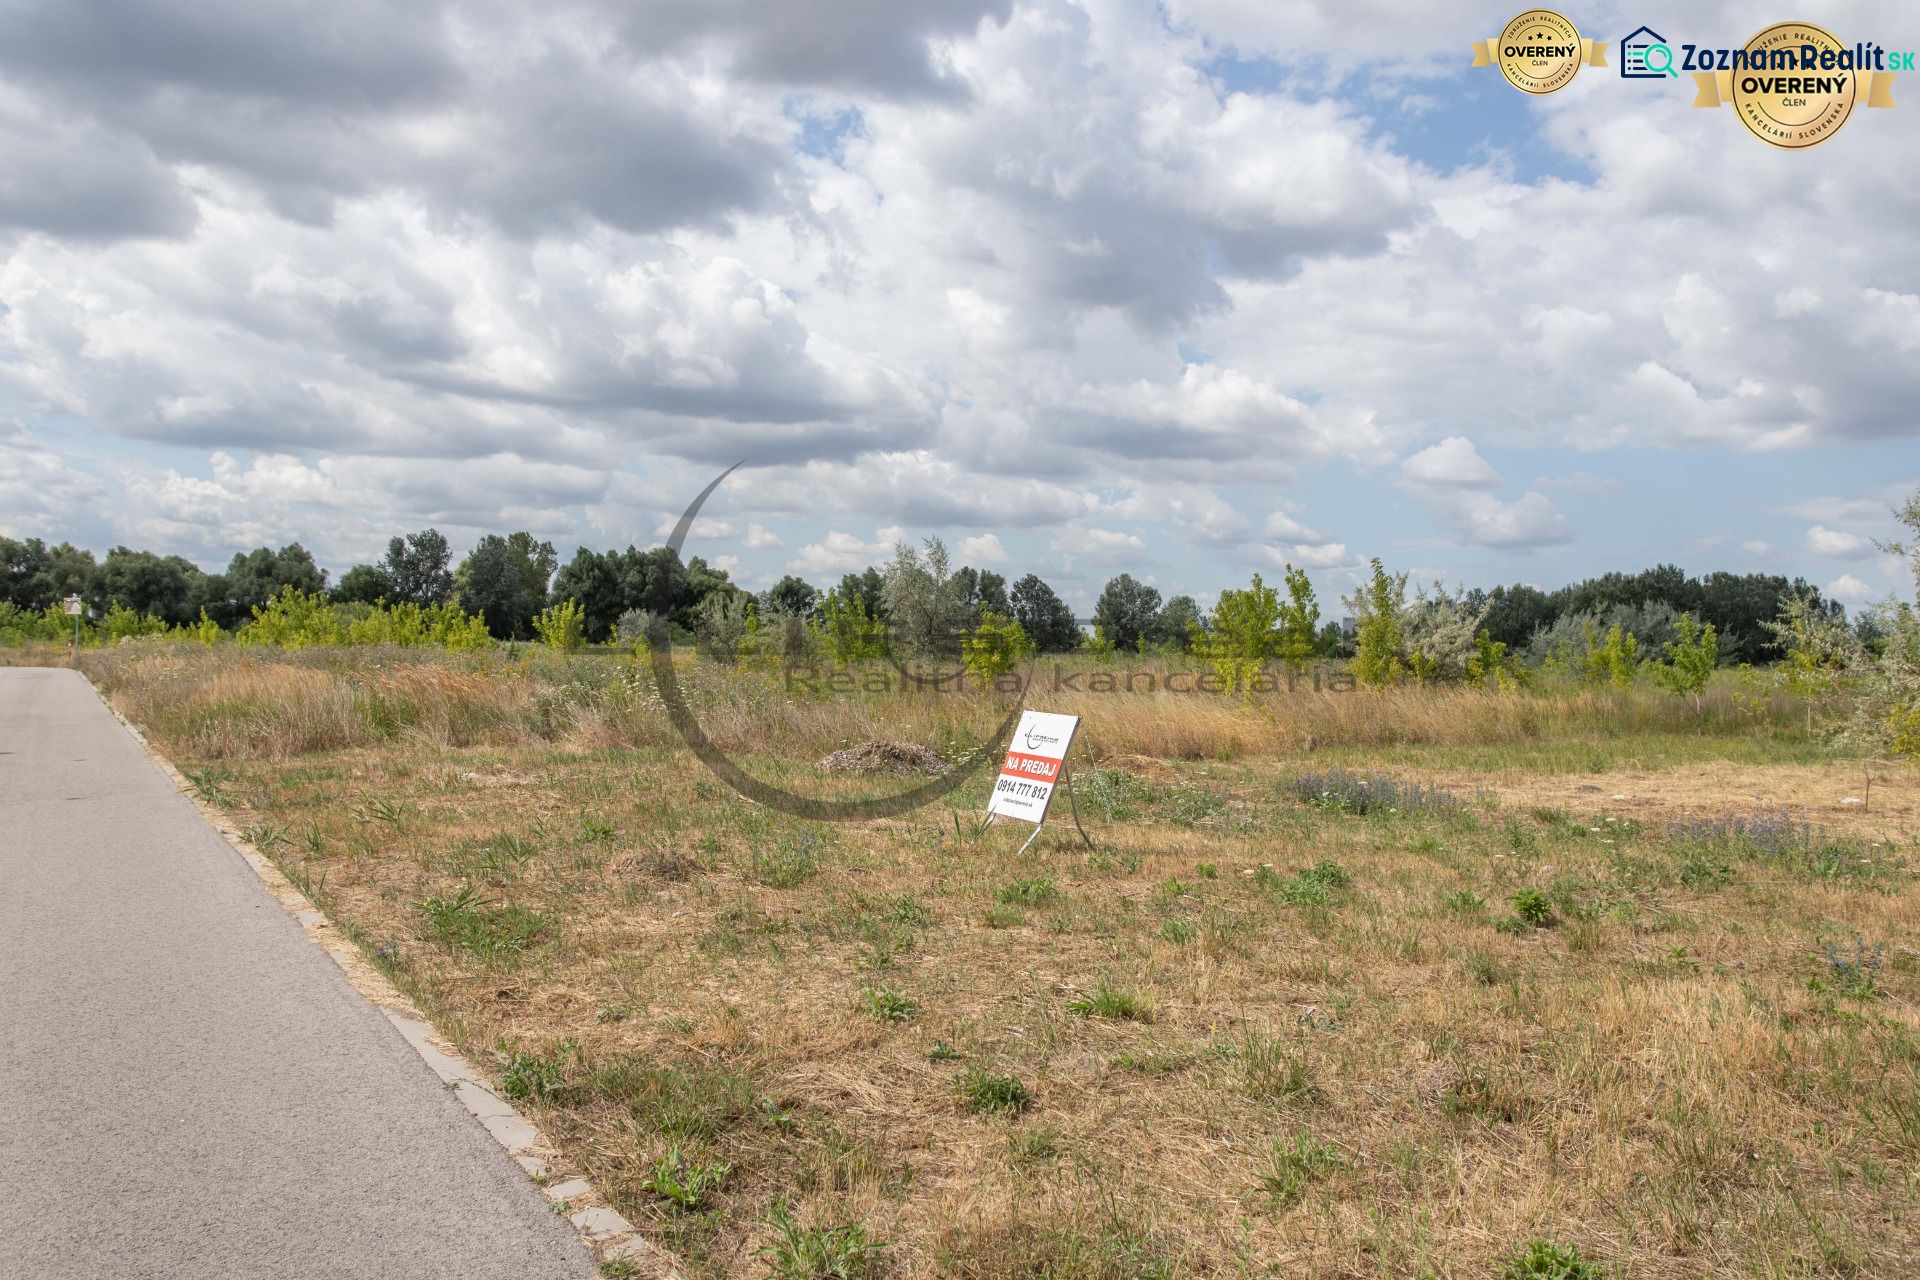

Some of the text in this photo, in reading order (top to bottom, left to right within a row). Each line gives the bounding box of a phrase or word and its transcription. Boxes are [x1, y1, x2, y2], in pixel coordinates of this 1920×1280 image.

[1006, 757, 1056, 777] NA PREDAJ
[998, 779, 1047, 800] 0914 777 812
